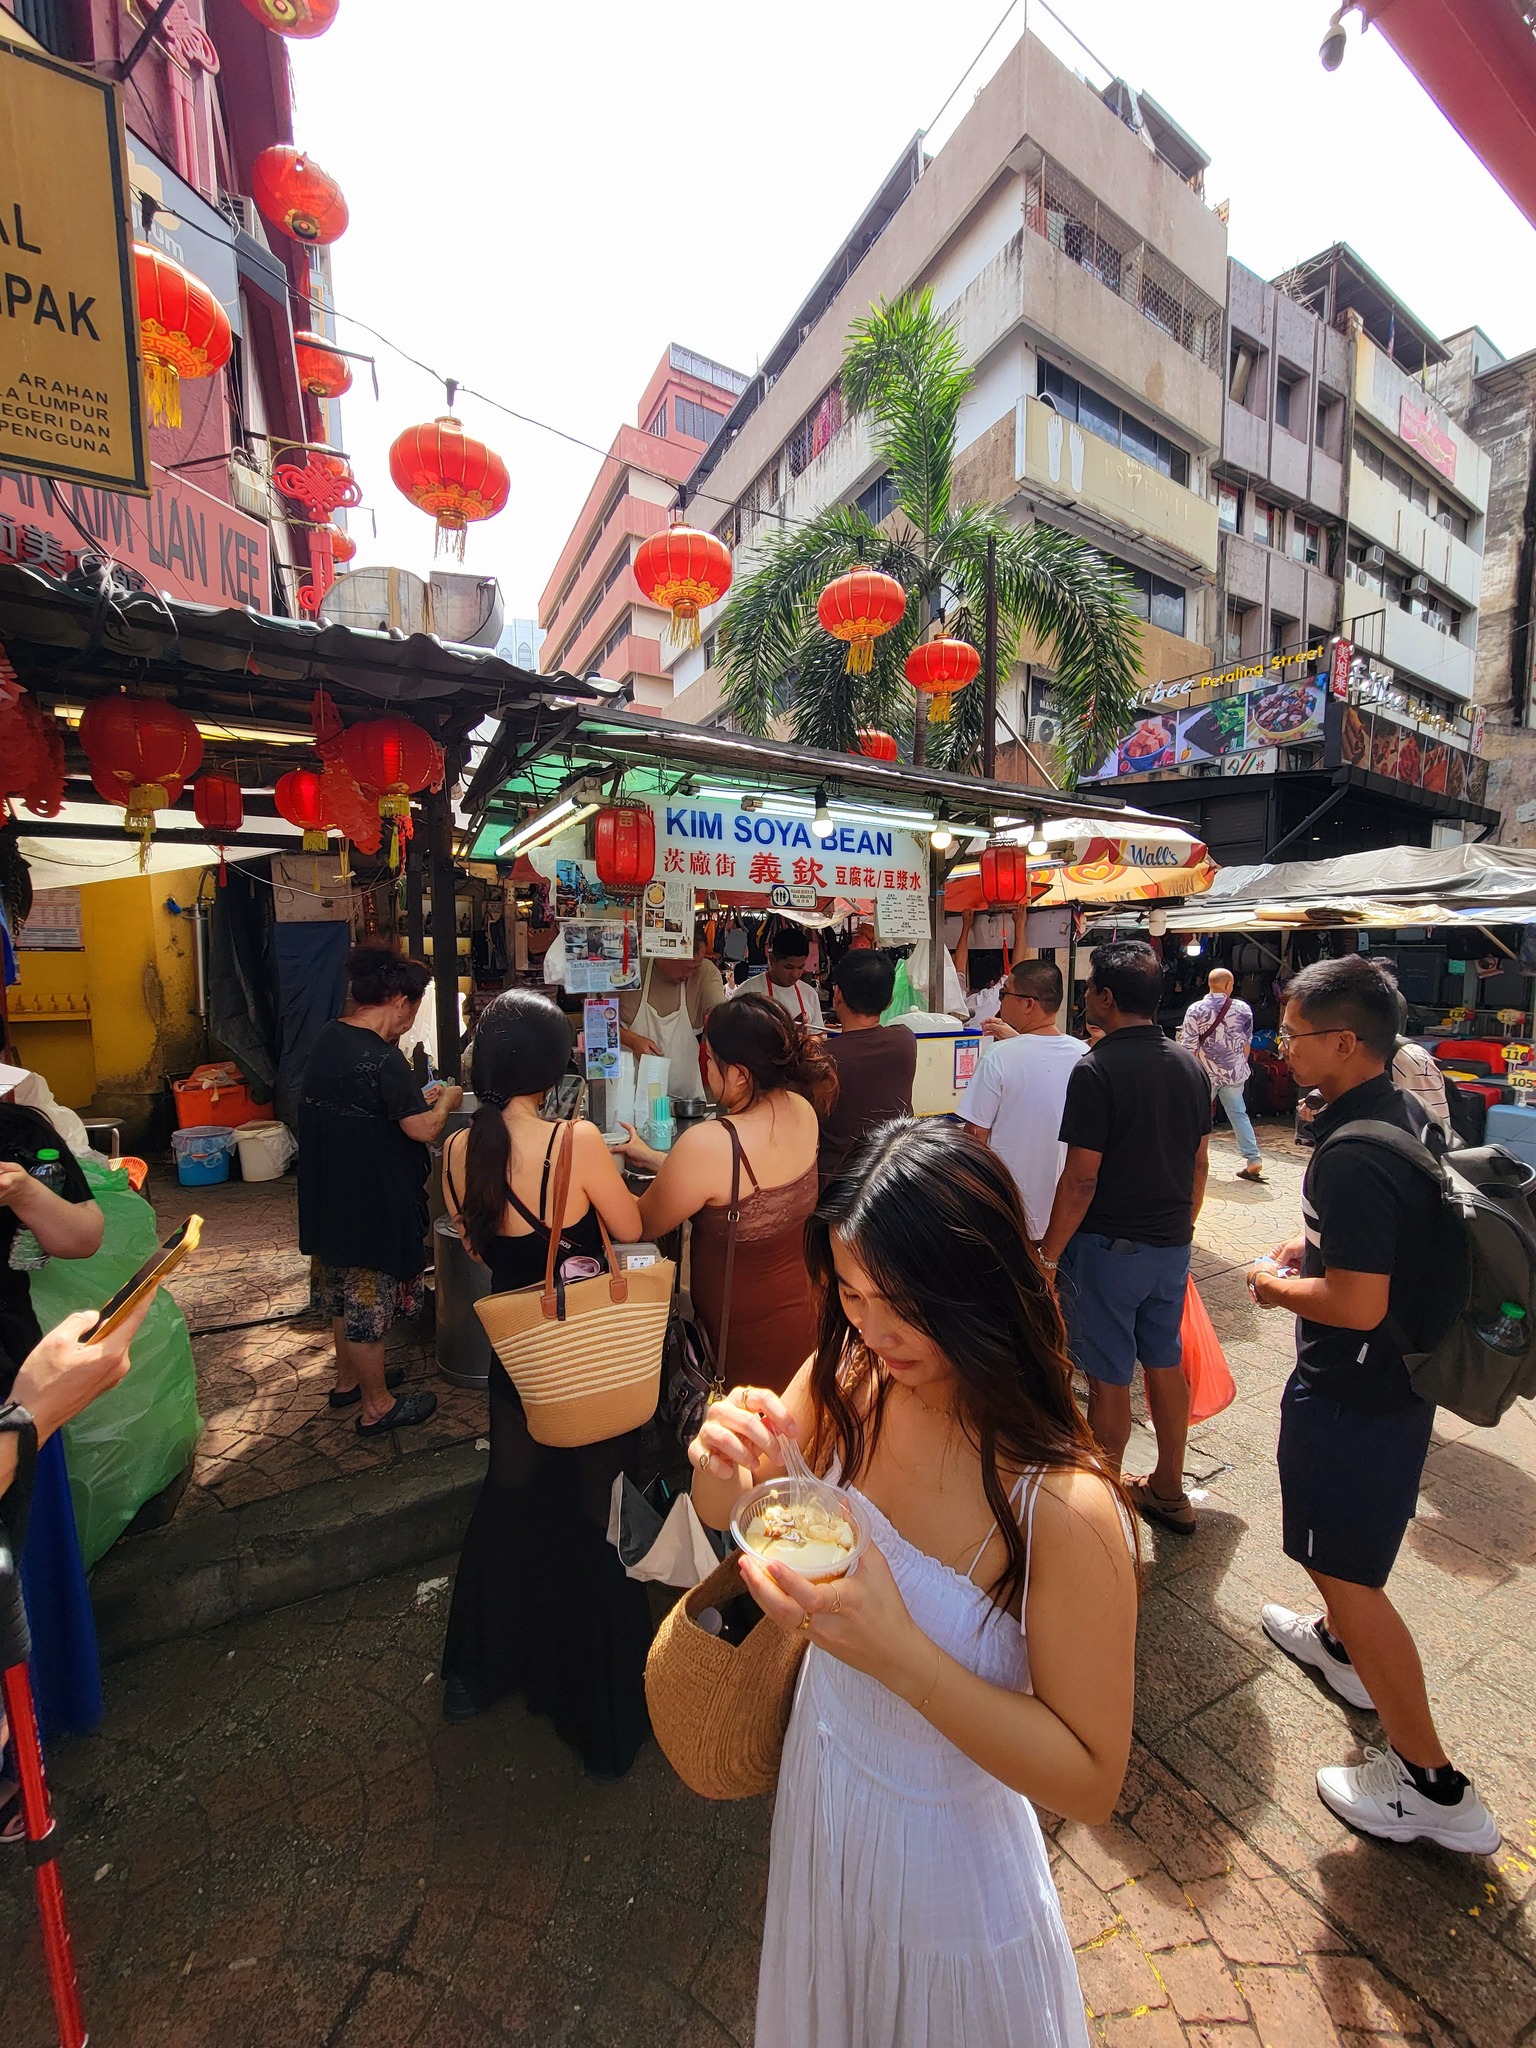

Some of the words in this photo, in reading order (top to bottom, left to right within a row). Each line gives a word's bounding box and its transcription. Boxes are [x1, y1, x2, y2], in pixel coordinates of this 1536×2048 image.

[0, 271, 101, 342] PAK
[0, 387, 19, 401] A
[28, 391, 109, 422] LUMPUR
[18, 372, 108, 405] ARAHAN
[0, 420, 111, 456] PENGGUNA
[70, 418, 110, 439] DAN
[146, 487, 208, 588] LIAN
[219, 522, 261, 611] KEE
[1200, 663, 1264, 689] Petaling
[1271, 645, 1325, 671] Street
[666, 807, 723, 840] KIM
[733, 815, 812, 849] SOYA
[821, 827, 893, 857] BEAN
[663, 847, 736, 877] 茨廠街
[1130, 844, 1179, 866] Wall's
[1505, 1050, 1529, 1061] 110
[1512, 1077, 1533, 1088] 105
